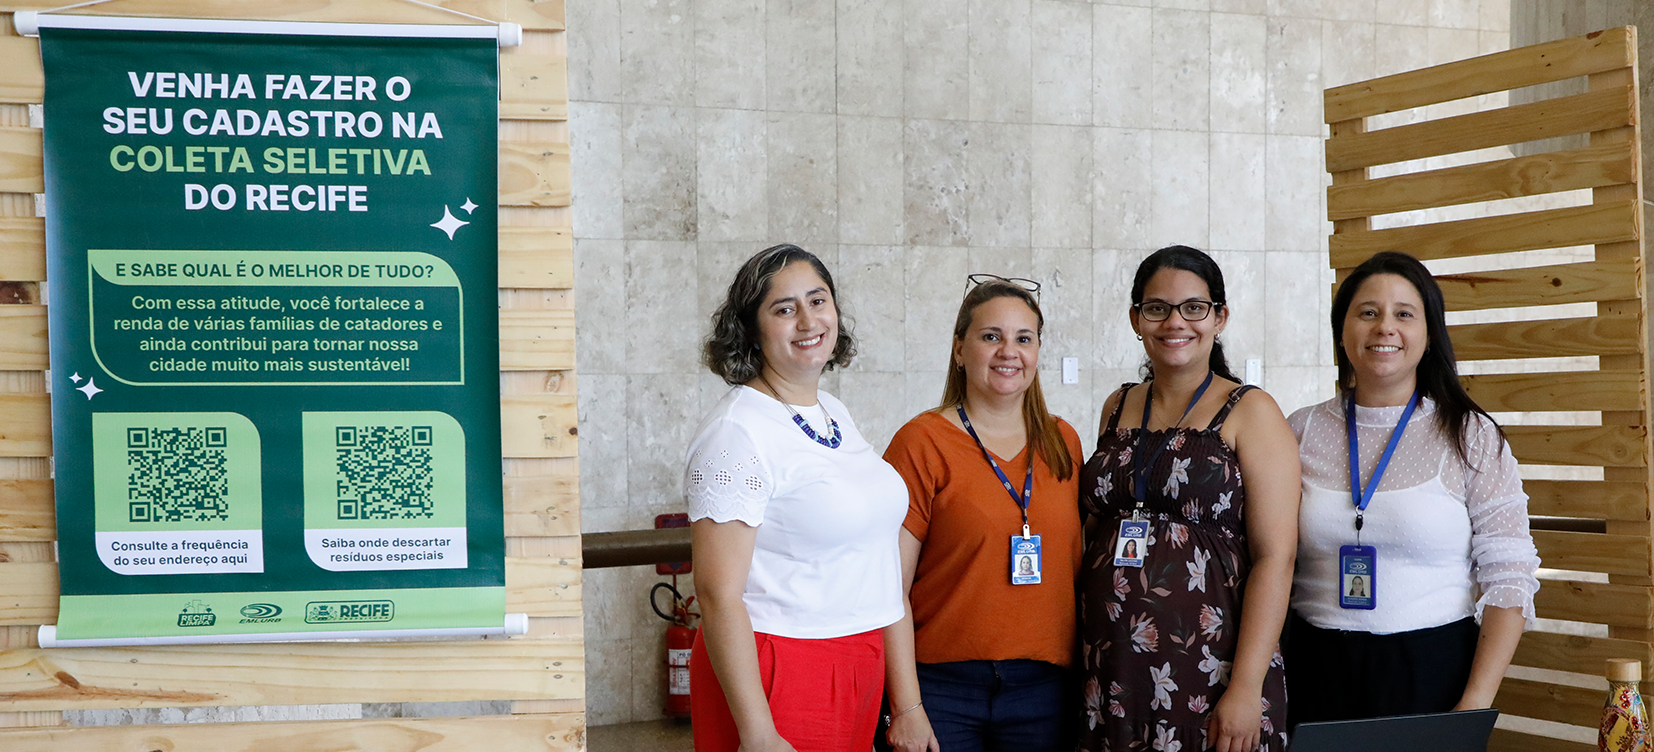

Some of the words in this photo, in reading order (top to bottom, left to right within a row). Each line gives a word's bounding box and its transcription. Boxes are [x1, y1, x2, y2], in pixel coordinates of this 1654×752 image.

[128, 72, 256, 98] VENHA
[266, 75, 376, 100] FAZER
[385, 76, 411, 101] O
[102, 107, 173, 134] SEU
[183, 109, 383, 137] CADASTRO
[392, 112, 443, 138] NA
[110, 145, 254, 173] COLETA
[263, 147, 431, 175] SELETIVA
[185, 184, 236, 210] DO
[246, 184, 368, 211] RECIFE
[116, 263, 125, 276] E
[131, 263, 177, 277] SABE
[182, 264, 231, 279] QUAL
[236, 260, 246, 277] É
[251, 264, 264, 278] O
[269, 264, 343, 278] MELHOR
[348, 265, 370, 278] DE
[375, 265, 434, 278] TUDO?
[132, 296, 171, 310] Com
[176, 299, 215, 310] essa
[220, 296, 285, 313] atitude,
[290, 296, 330, 311] você
[335, 296, 410, 311] fortalece
[414, 300, 424, 311] a
[114, 317, 163, 331] renda
[168, 317, 189, 331] de
[194, 316, 245, 331] várias
[249, 316, 314, 331] famílias
[319, 317, 340, 331] de
[344, 317, 428, 331] catadores
[432, 320, 443, 331] e
[139, 337, 186, 351] ainda
[191, 337, 267, 351] contribui
[271, 340, 309, 354] para
[313, 338, 365, 351] tornar
[369, 340, 418, 351] nossa
[149, 358, 207, 372] cidade
[211, 358, 259, 372] muito
[264, 358, 303, 372] mais
[308, 357, 410, 372] sustentável!
[111, 540, 168, 551] Consulte
[171, 542, 179, 551] a
[181, 540, 249, 552] frequência
[321, 537, 355, 549] Saiba
[359, 538, 389, 548] onde
[392, 537, 451, 548] descartar
[113, 555, 130, 566] do
[133, 557, 155, 566] seu
[158, 555, 218, 566] endereço
[222, 554, 248, 566] aqui
[330, 551, 383, 563] resíduos
[386, 550, 444, 564] especiais
[340, 604, 389, 618] RECIFE
